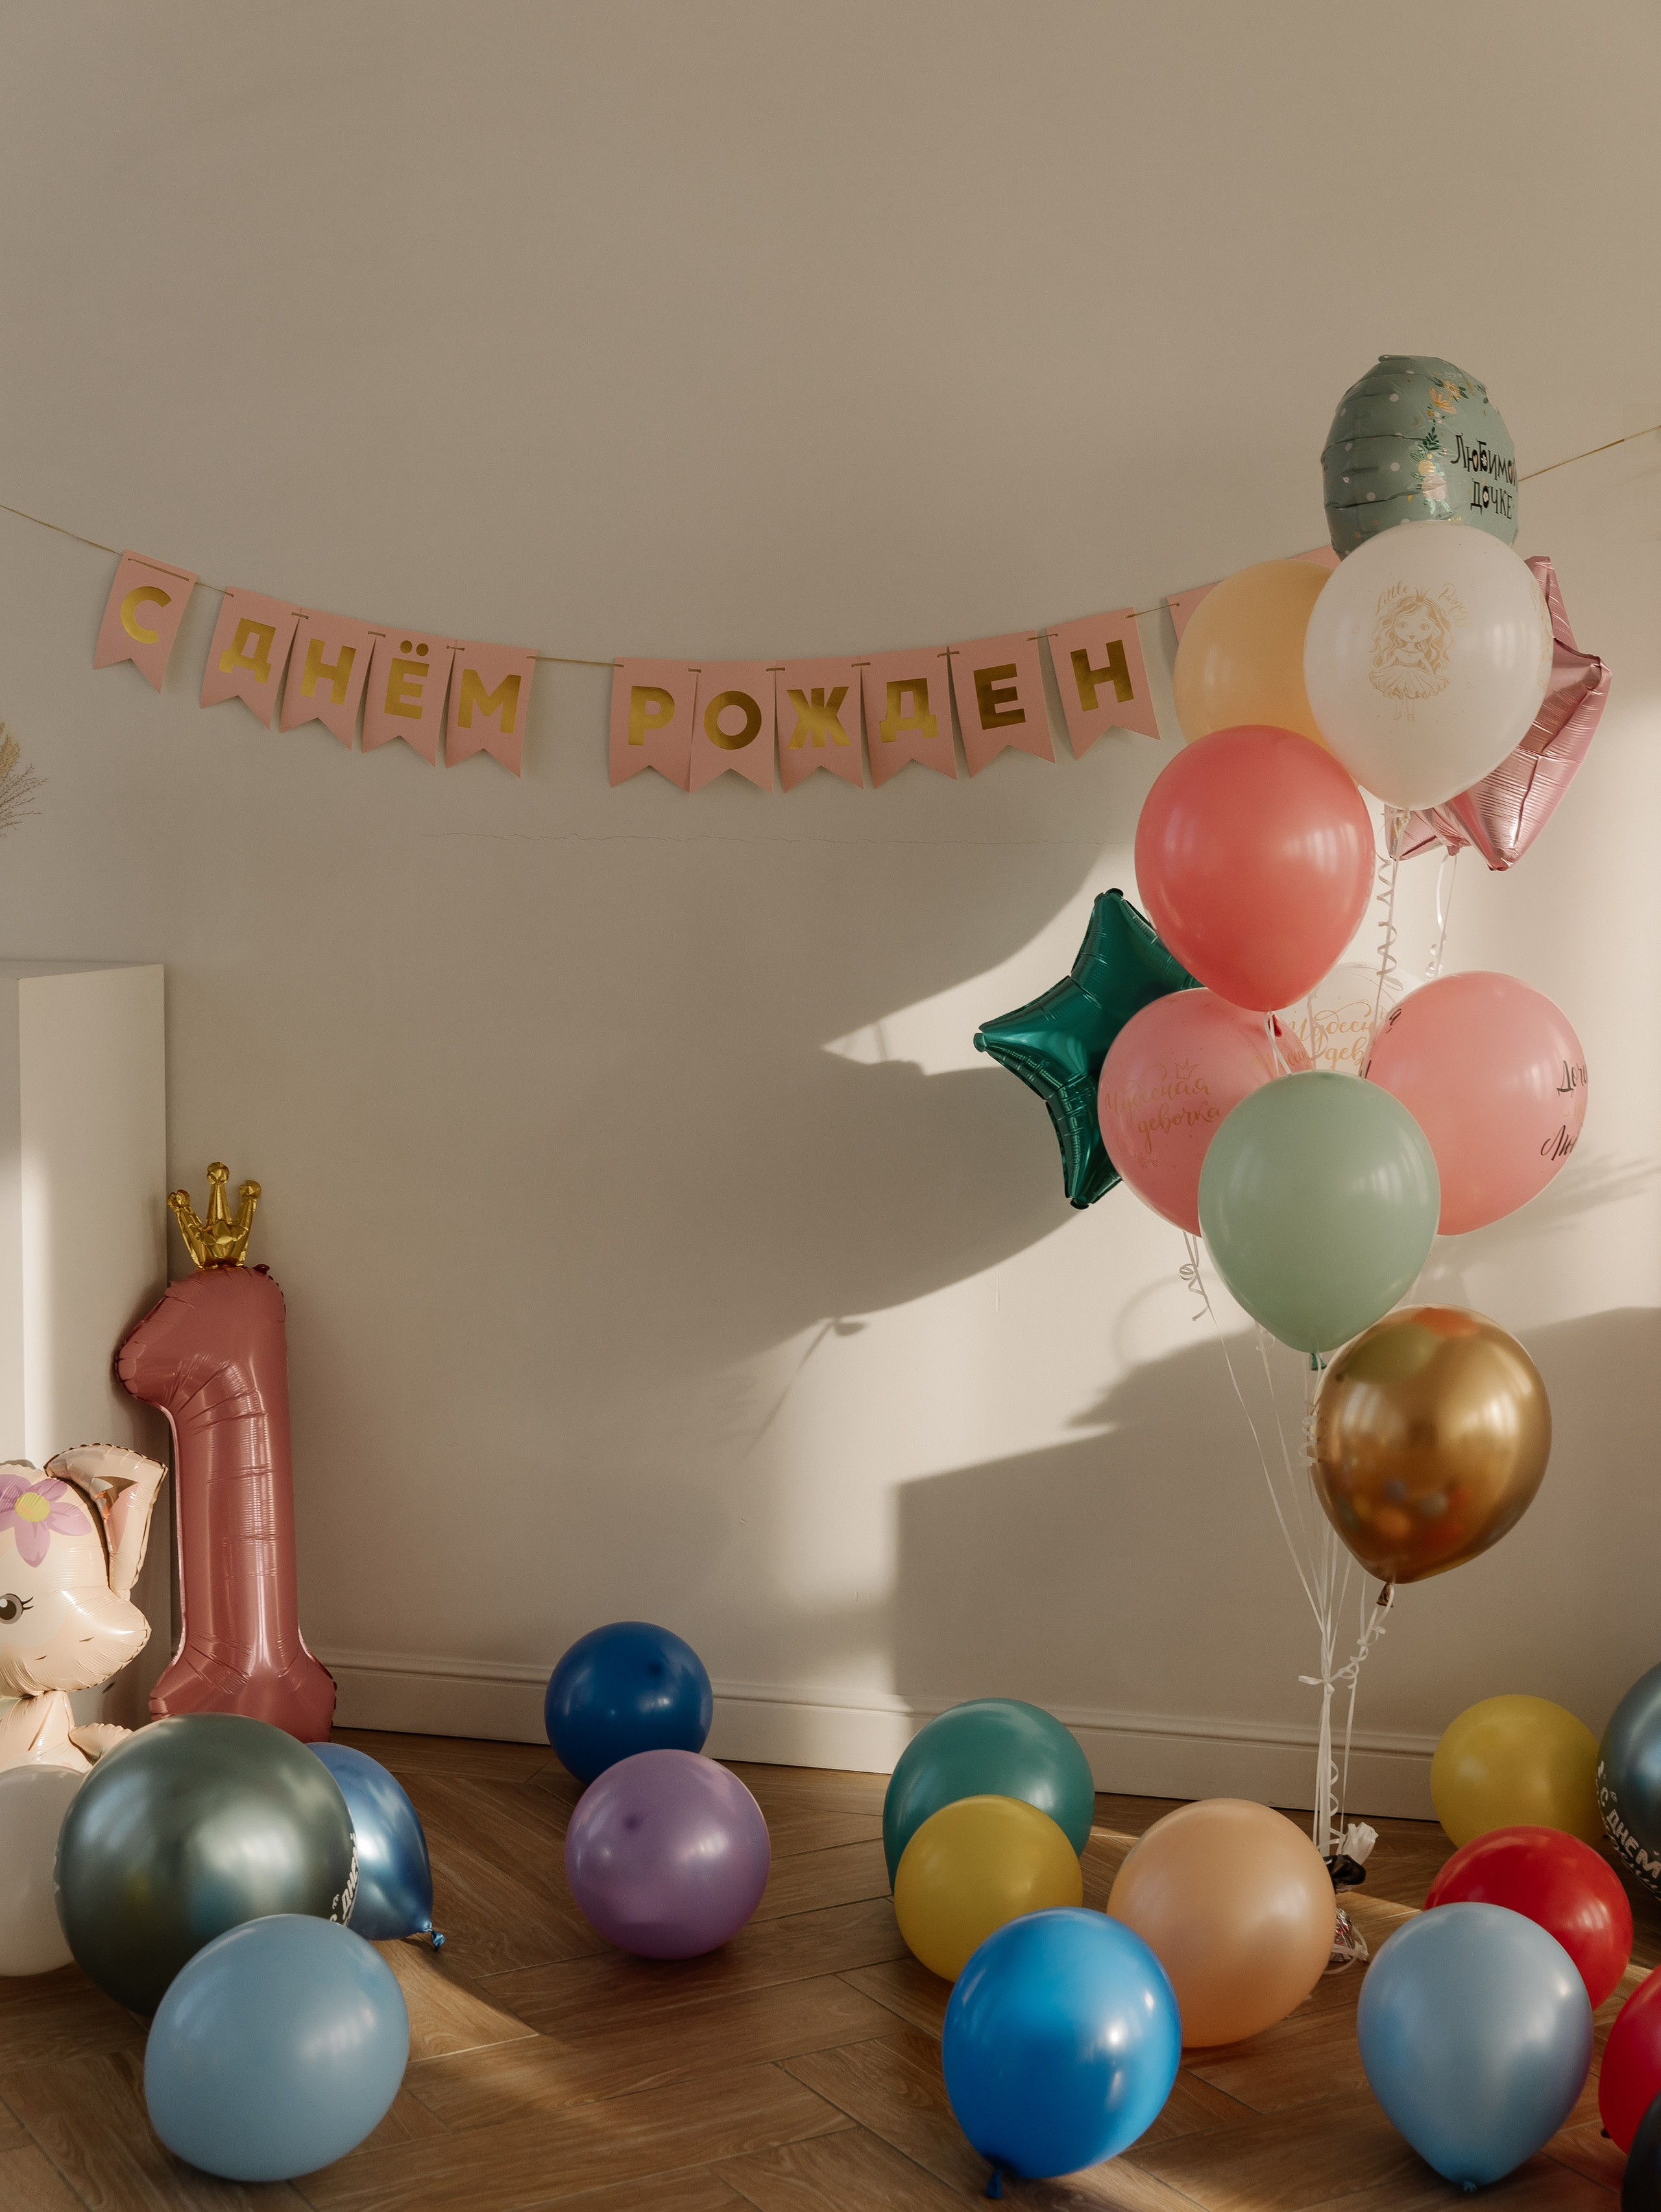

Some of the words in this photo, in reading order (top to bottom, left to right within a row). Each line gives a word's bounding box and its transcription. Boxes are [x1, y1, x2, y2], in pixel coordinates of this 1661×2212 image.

[1374, 579, 1410, 616] Little
[120, 586, 172, 644] С
[218, 617, 522, 734] ДНЁМ
[627, 639, 1134, 751] РОЖДЕН
[1289, 999, 1374, 1053] Чудесн
[1104, 1064, 1211, 1127] Чудесная
[1138, 1101, 1220, 1154] девочка
